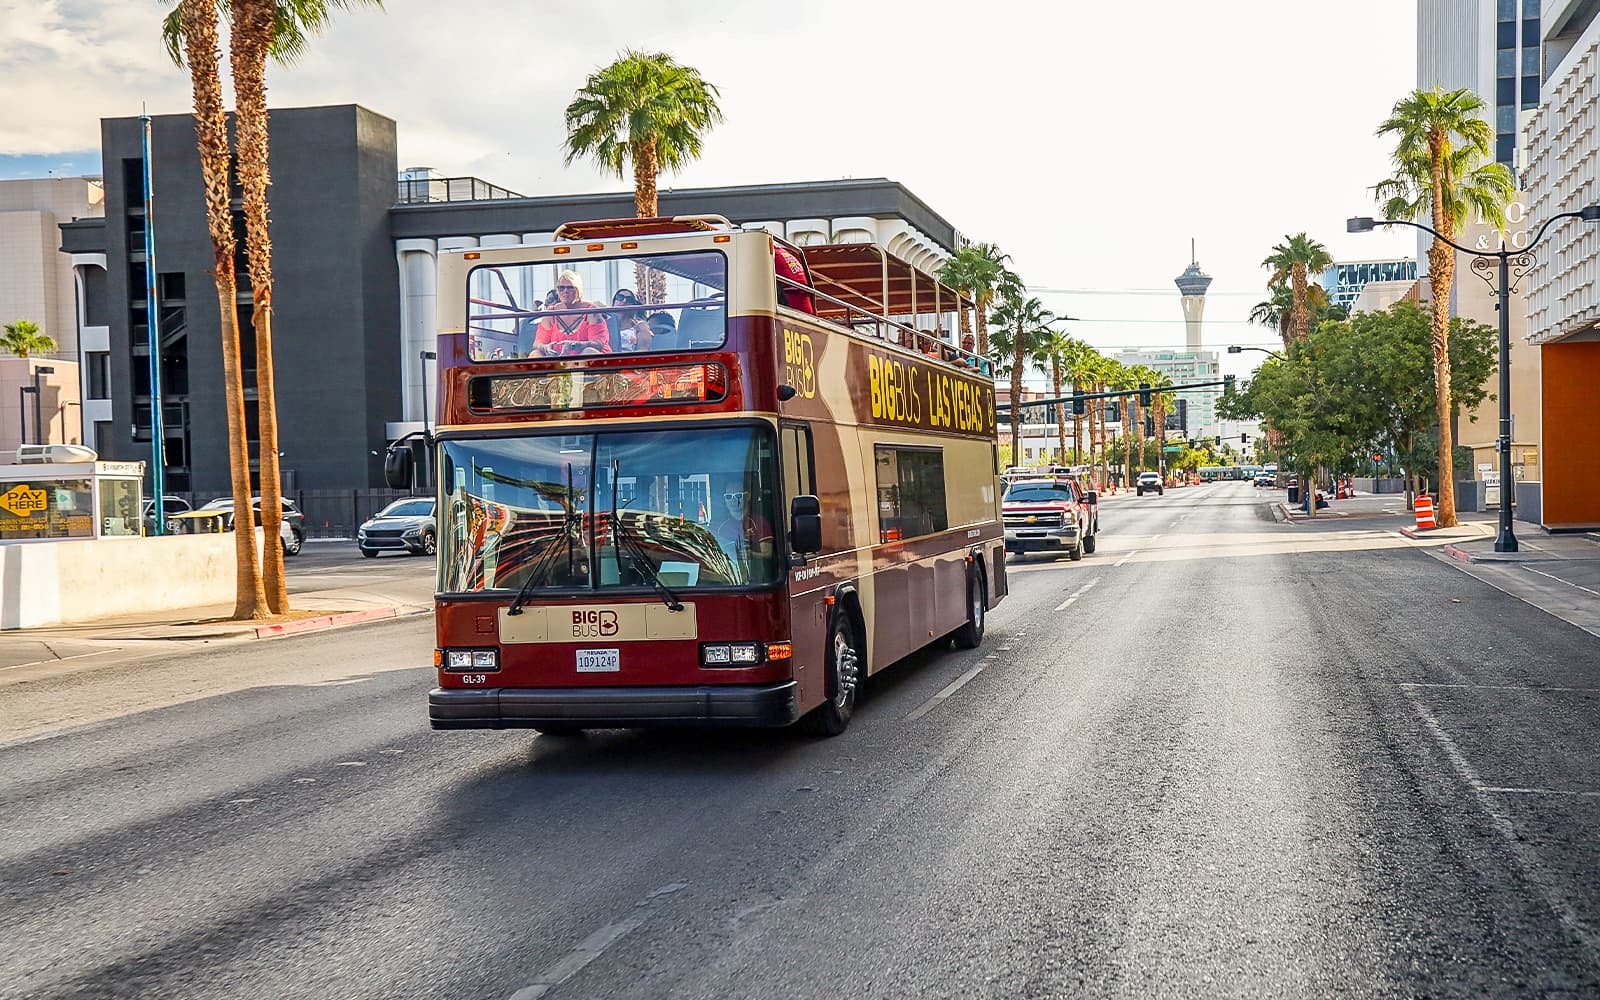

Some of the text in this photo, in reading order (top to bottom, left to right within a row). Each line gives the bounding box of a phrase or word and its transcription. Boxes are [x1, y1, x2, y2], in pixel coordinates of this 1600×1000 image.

[1475, 234, 1489, 249] &
[783, 329, 802, 366] BIG
[786, 365, 805, 398] BUS
[927, 370, 951, 428] LAS
[950, 378, 983, 433] VEGAS
[7, 491, 43, 501] PAY
[8, 500, 44, 510] HERE
[572, 610, 598, 625] BIG
[572, 624, 599, 638] BUS
[579, 656, 617, 668] 109124P
[463, 674, 486, 684] GL-39
